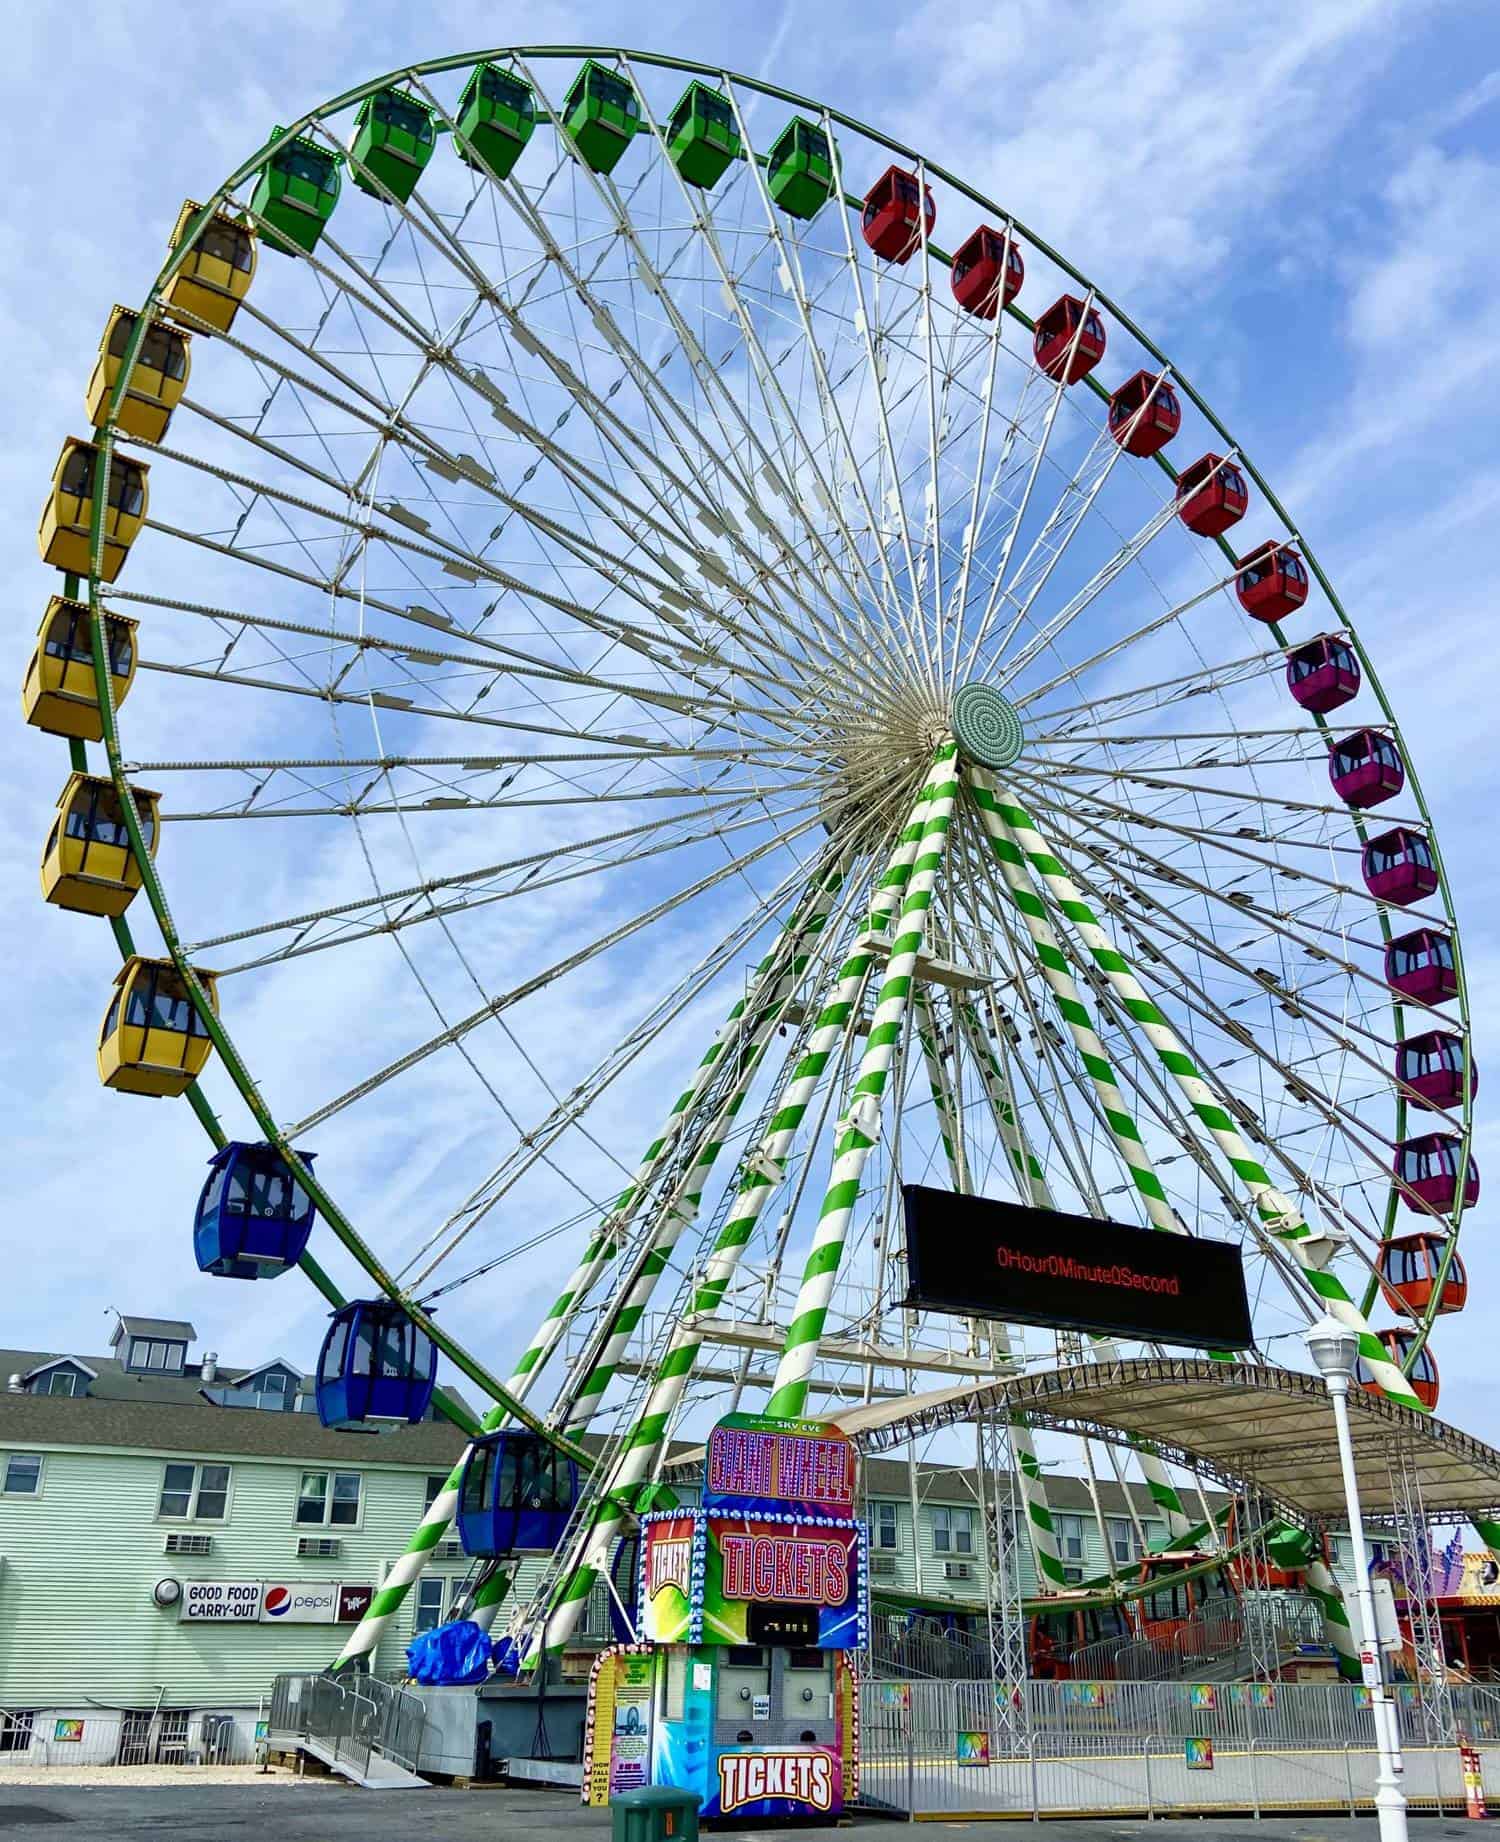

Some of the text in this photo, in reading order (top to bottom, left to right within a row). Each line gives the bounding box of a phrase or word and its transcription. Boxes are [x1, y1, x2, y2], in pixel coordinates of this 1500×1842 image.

[776, 1420, 799, 1431] SKY
[711, 1428, 852, 1502] GIANT WHEEL
[651, 1541, 690, 1599] TICKETS
[722, 1535, 845, 1602] TICKETS
[189, 1586, 259, 1600] GOOD FOOD
[293, 1593, 333, 1608] pepsi
[188, 1603, 256, 1617] CARRY-OUT
[722, 1757, 829, 1807] TICKETS
[596, 1793, 604, 1803] ?
